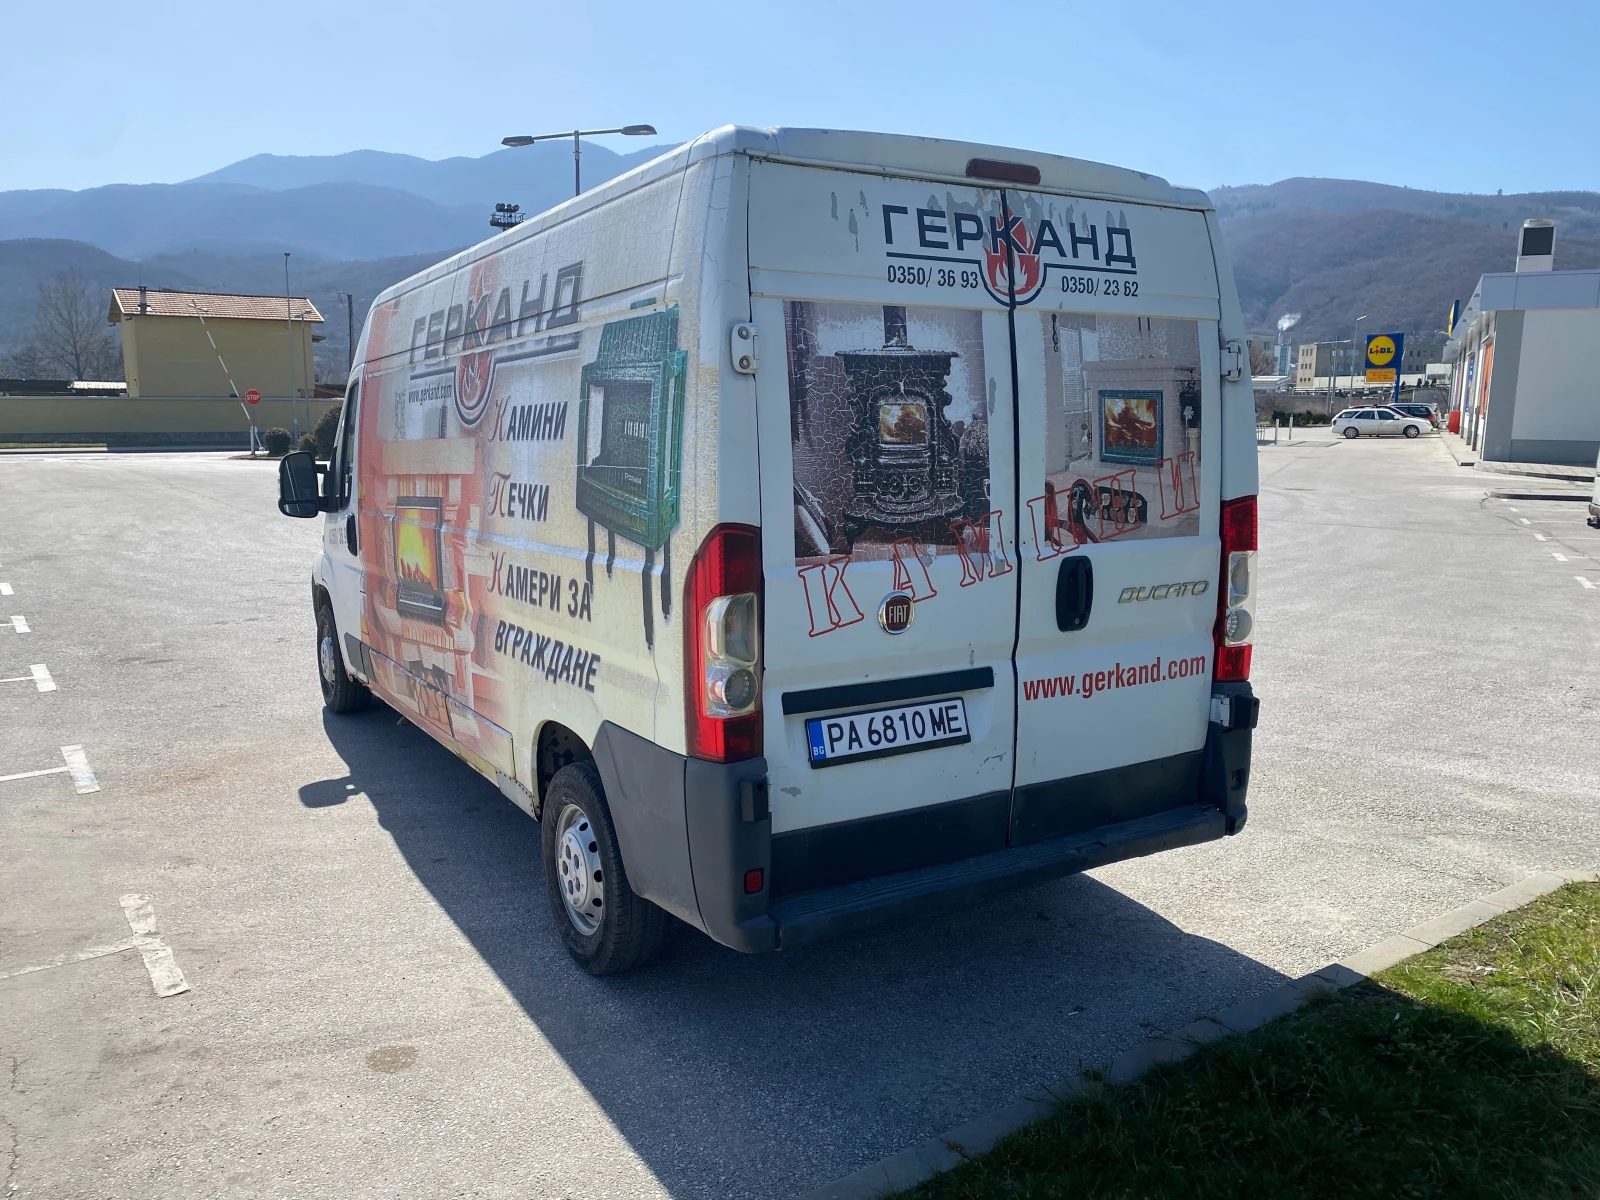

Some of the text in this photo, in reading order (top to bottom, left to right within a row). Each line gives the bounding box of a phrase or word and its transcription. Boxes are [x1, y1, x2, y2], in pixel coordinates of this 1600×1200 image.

[882, 204, 1137, 268] ГЕРКАНД
[887, 265, 979, 289] 0350/ 36 93
[1061, 275, 1139, 297] 0350/ 23 62
[409, 260, 584, 364] ГЕРКАНД
[567, 579, 593, 622] ЗА
[1118, 580, 1210, 604] DUCATO
[888, 604, 909, 624] FIAT
[495, 619, 601, 693] ВГРАЖДАНЕ
[1023, 655, 1206, 700] www.gerkand.com
[813, 745, 825, 756] BG
